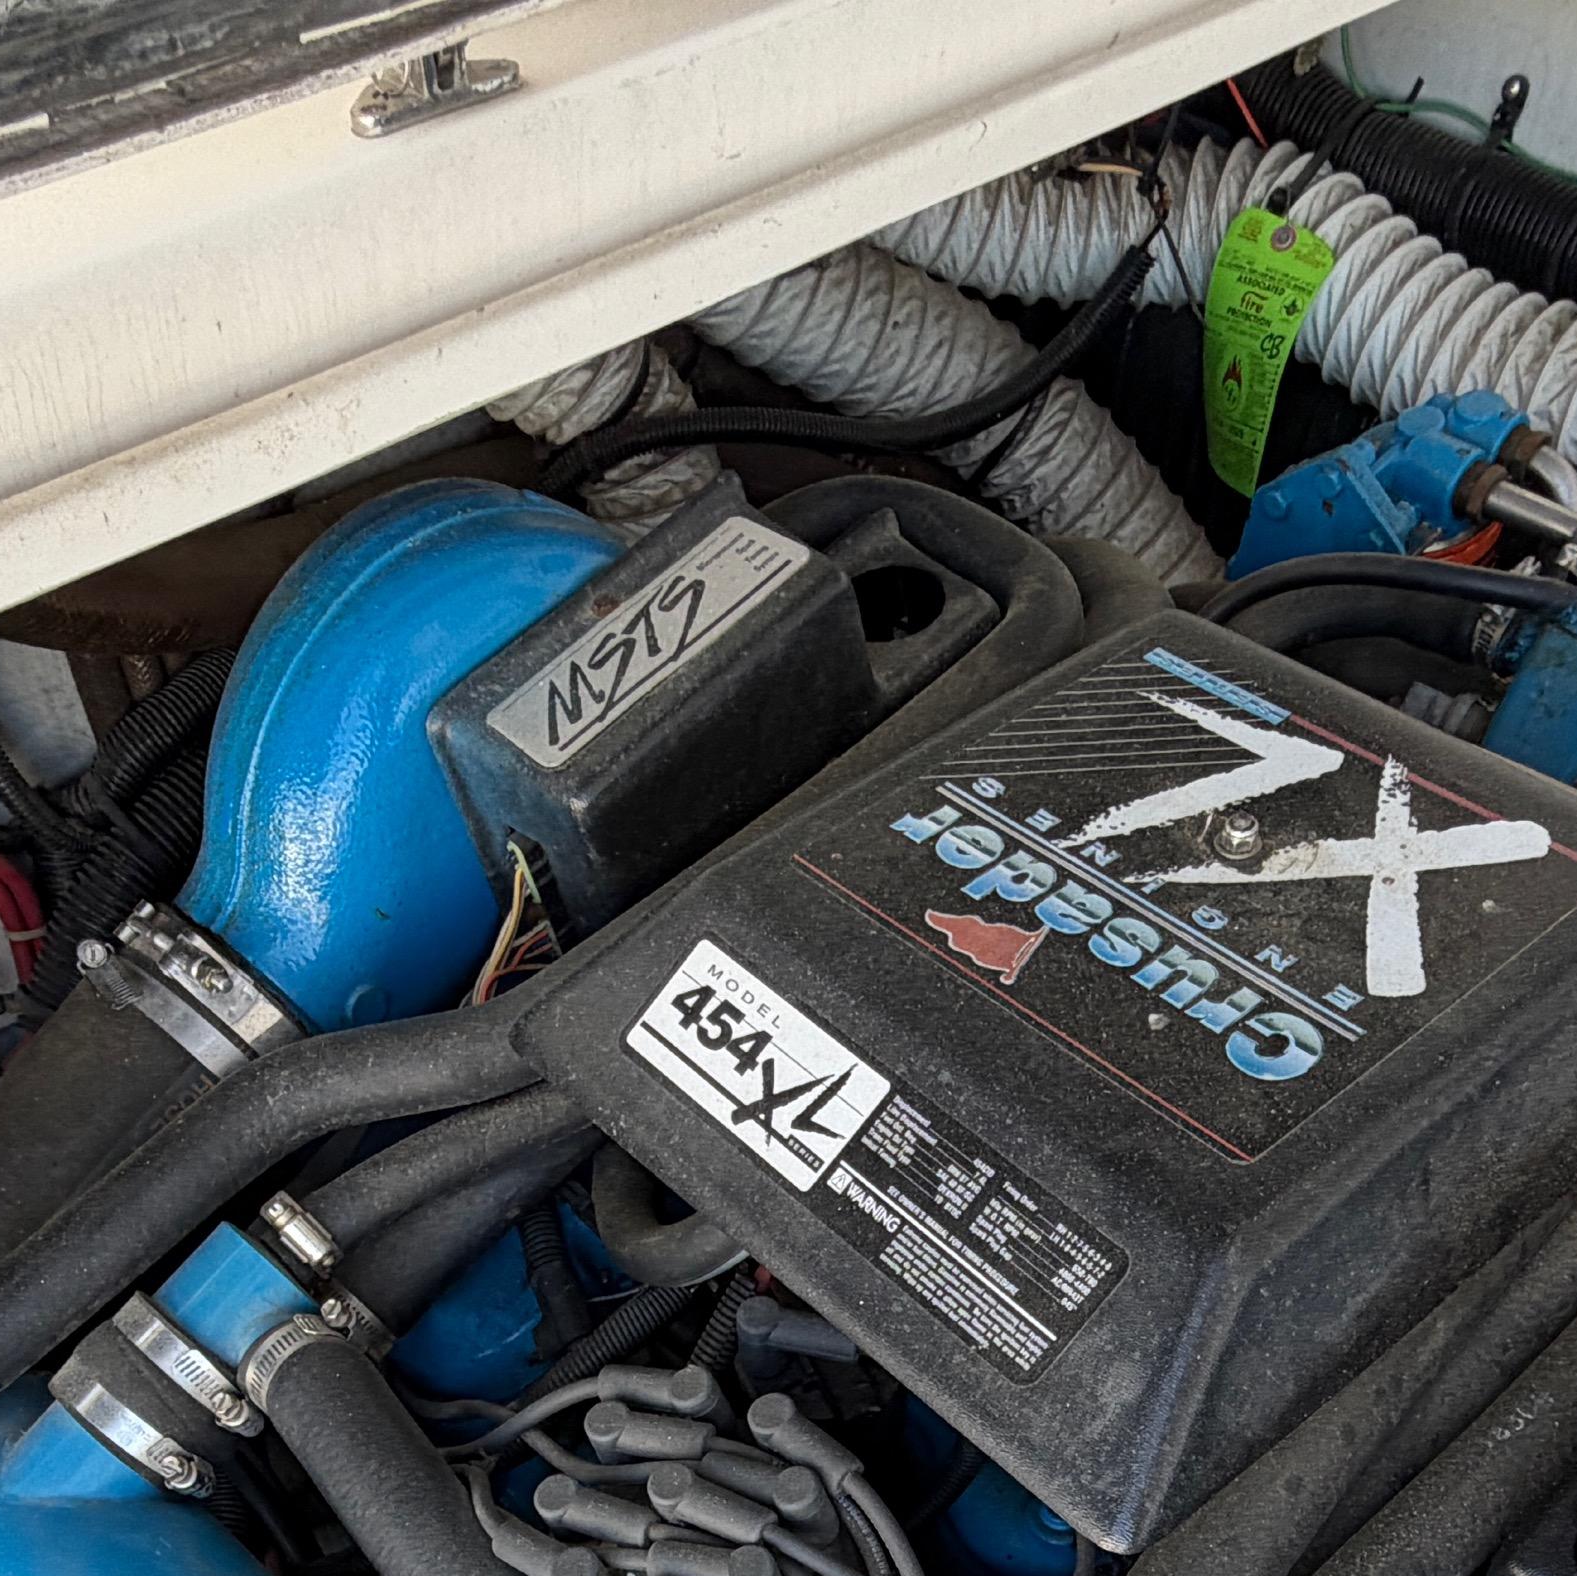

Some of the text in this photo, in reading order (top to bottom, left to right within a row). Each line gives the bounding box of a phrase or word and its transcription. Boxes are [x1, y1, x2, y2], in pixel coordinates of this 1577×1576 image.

[548, 576, 706, 747] MSTS
[972, 776, 1364, 1012] ENGINES
[1055, 691, 1552, 997] XL
[706, 964, 782, 1029] MODEL
[891, 804, 1325, 1082] Crusader
[671, 984, 859, 1148] 454 XL
[787, 1137, 821, 1169] SERIES
[845, 1181, 901, 1234] WARNING
